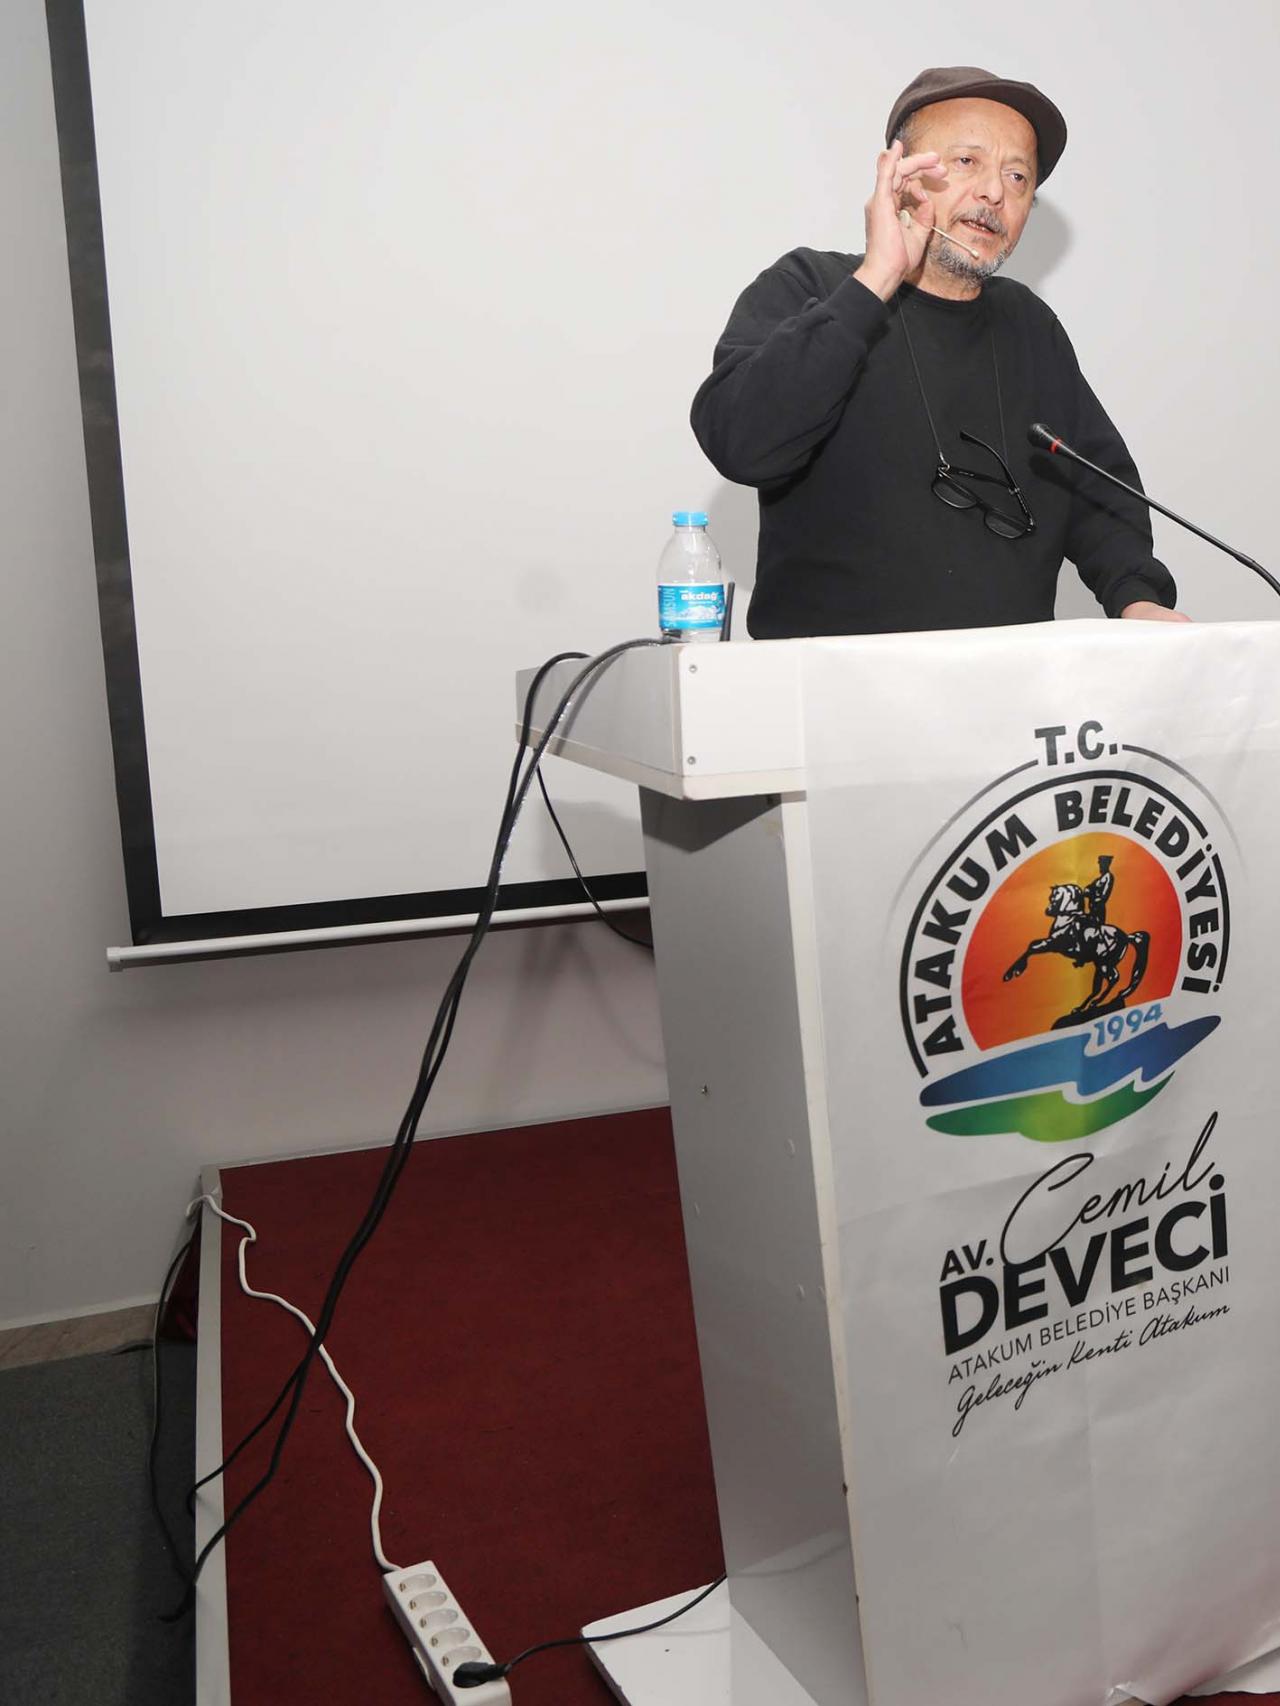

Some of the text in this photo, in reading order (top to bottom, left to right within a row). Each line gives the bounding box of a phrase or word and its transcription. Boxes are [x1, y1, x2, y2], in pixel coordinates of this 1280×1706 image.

[1034, 720, 1118, 767] T.C.
[914, 784, 1221, 1057] ATAKUM BELEDİYESİ
[1093, 1003, 1163, 1047] 1994
[939, 1111, 1219, 1283] AV. Cemil
[939, 1174, 1229, 1356] DEVECİ
[948, 1266, 1230, 1385] ATAKUM BELEDİYE BAŞKANI
[952, 1305, 1231, 1438] Geleceğin Kenti Atakum
